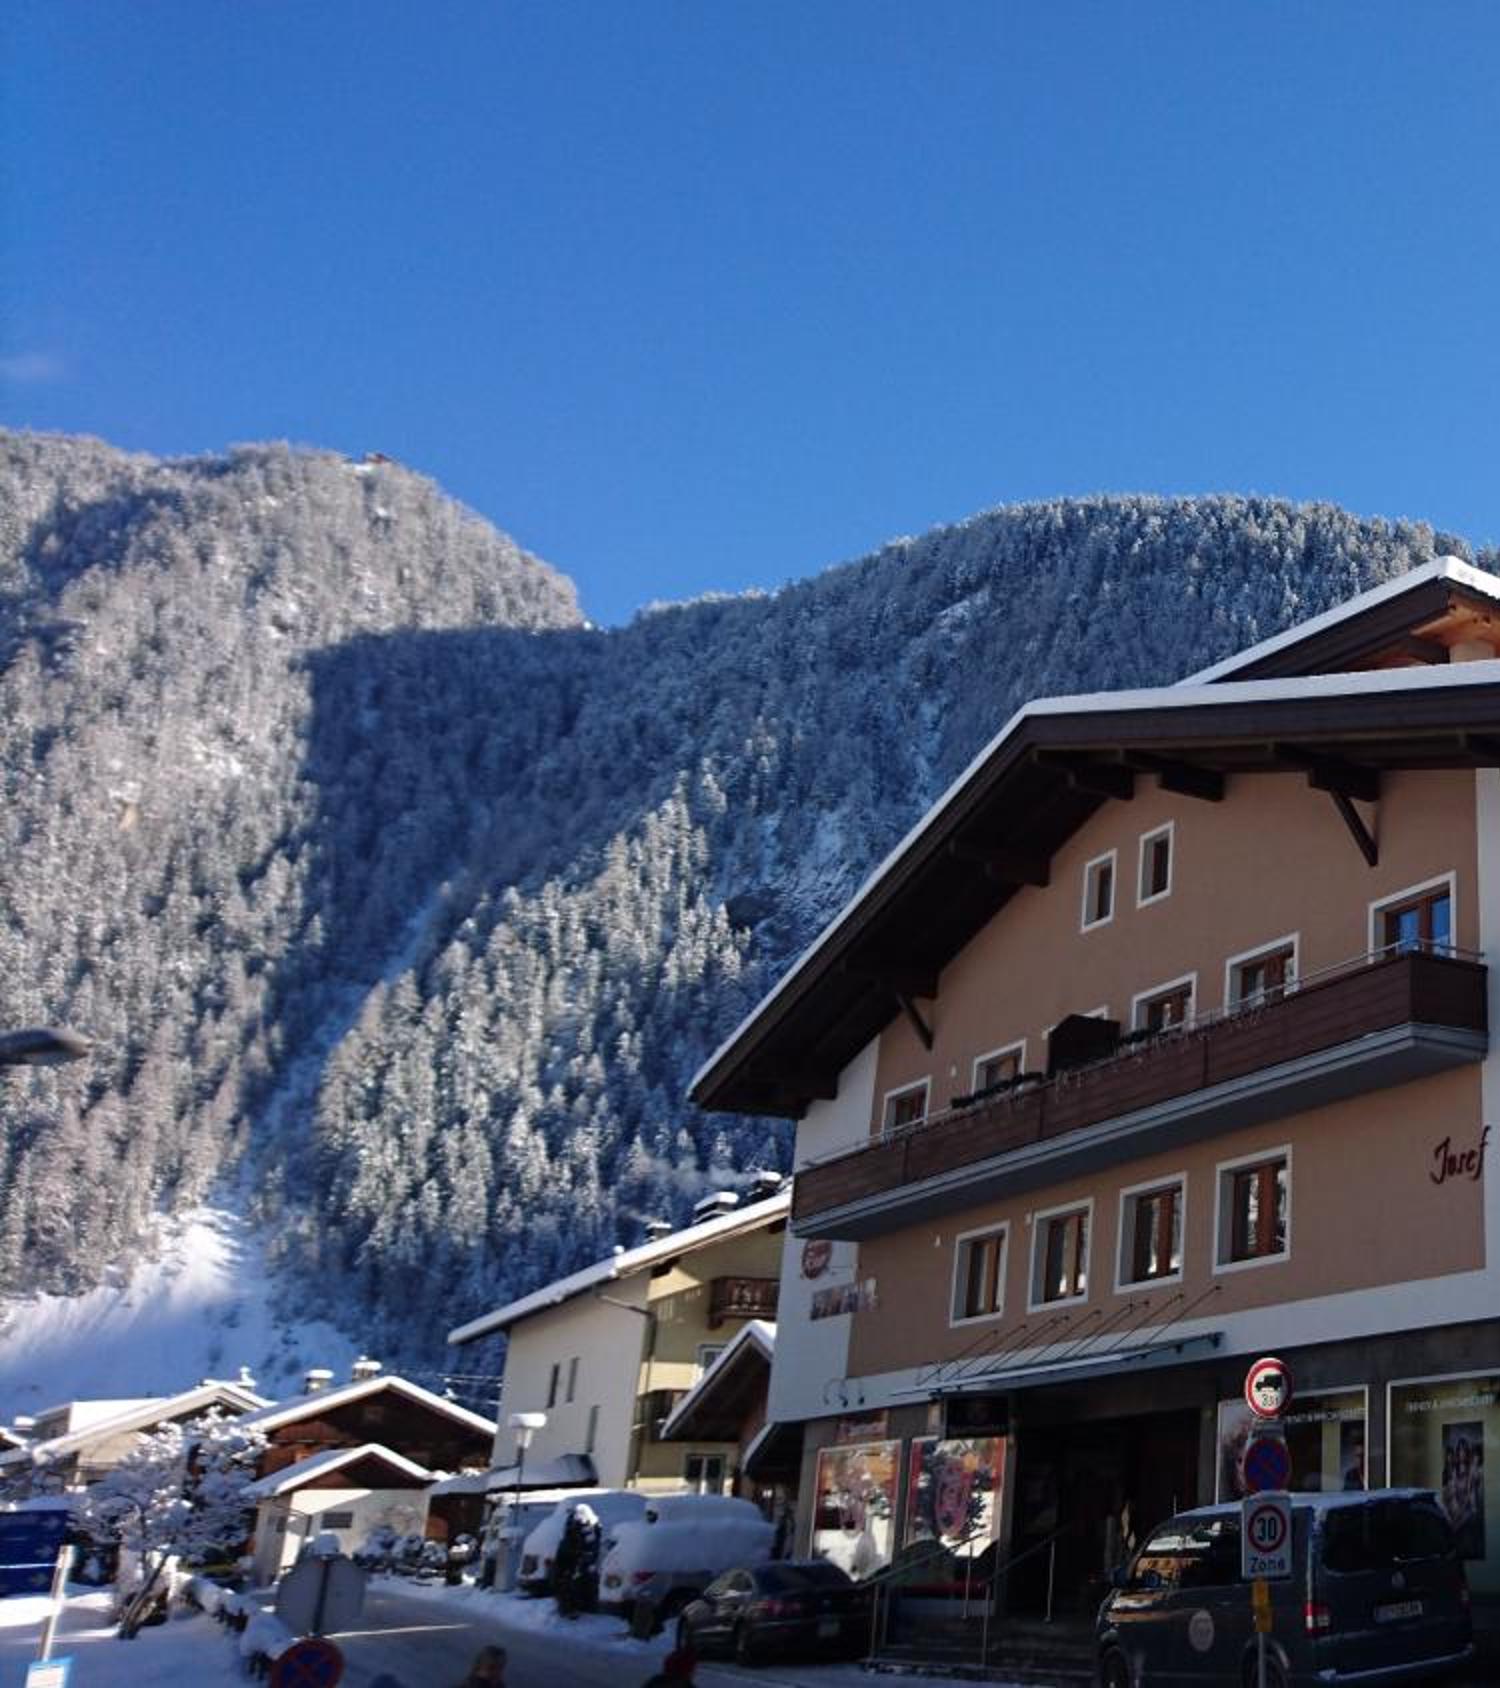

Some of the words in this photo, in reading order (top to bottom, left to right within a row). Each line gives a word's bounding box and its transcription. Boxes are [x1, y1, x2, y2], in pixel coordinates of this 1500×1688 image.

[1430, 1125, 1490, 1185] Josef
[1257, 1516, 1277, 1541] 30
[1250, 1556, 1285, 1574] Zone
